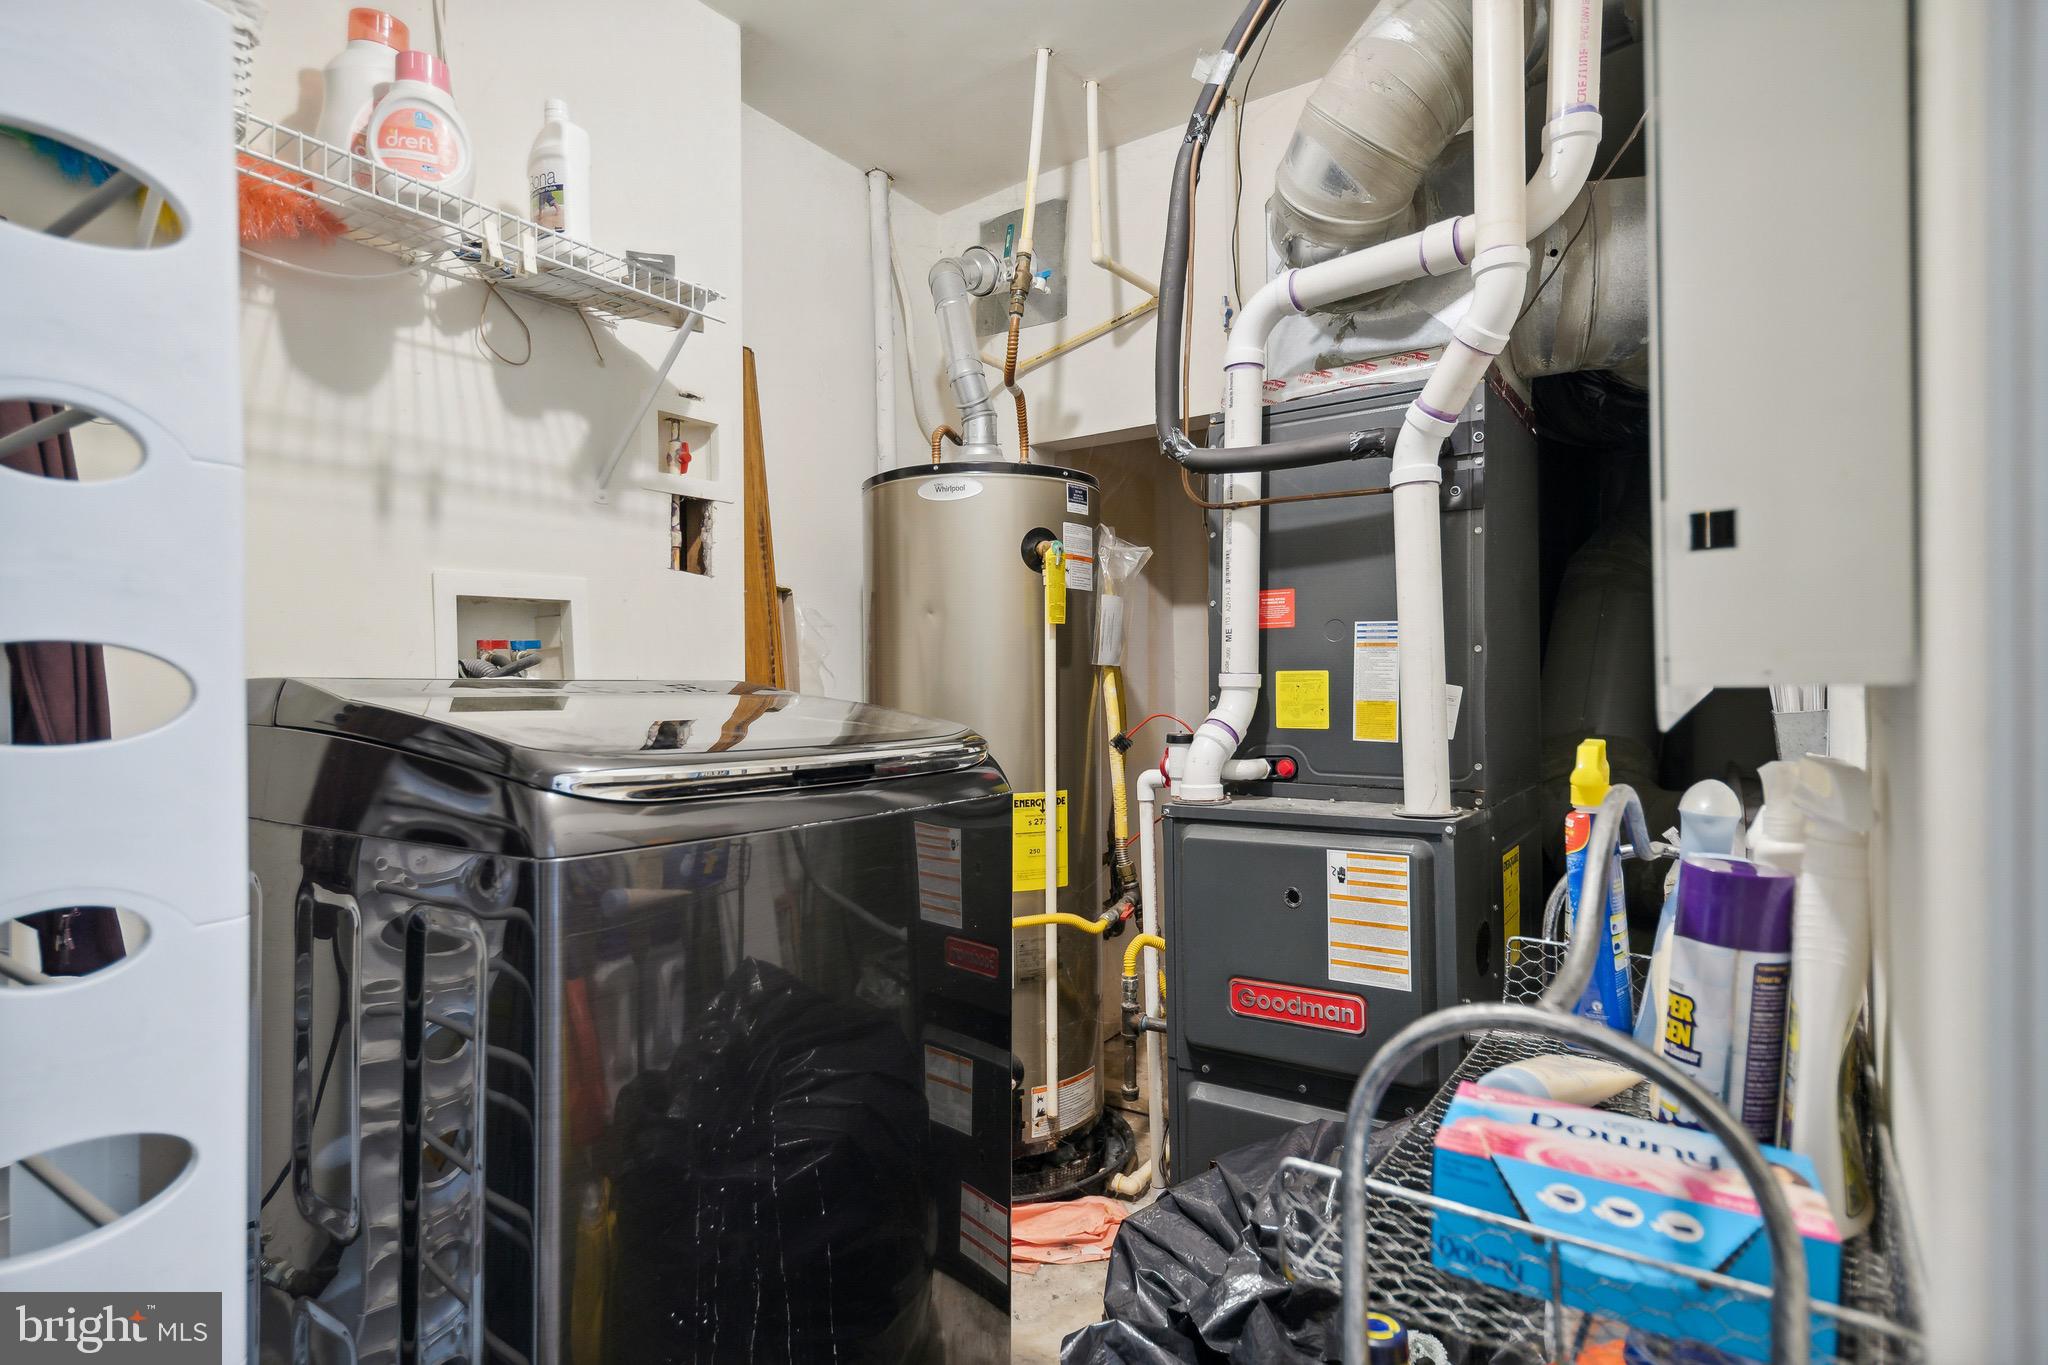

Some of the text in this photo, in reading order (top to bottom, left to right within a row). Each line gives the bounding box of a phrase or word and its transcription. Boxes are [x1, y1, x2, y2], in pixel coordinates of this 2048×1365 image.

[385, 128, 434, 152] dreft
[934, 484, 966, 493] Whirlpool
[1238, 988, 1355, 1024] Goodman
[1530, 1112, 1720, 1171] Downy
